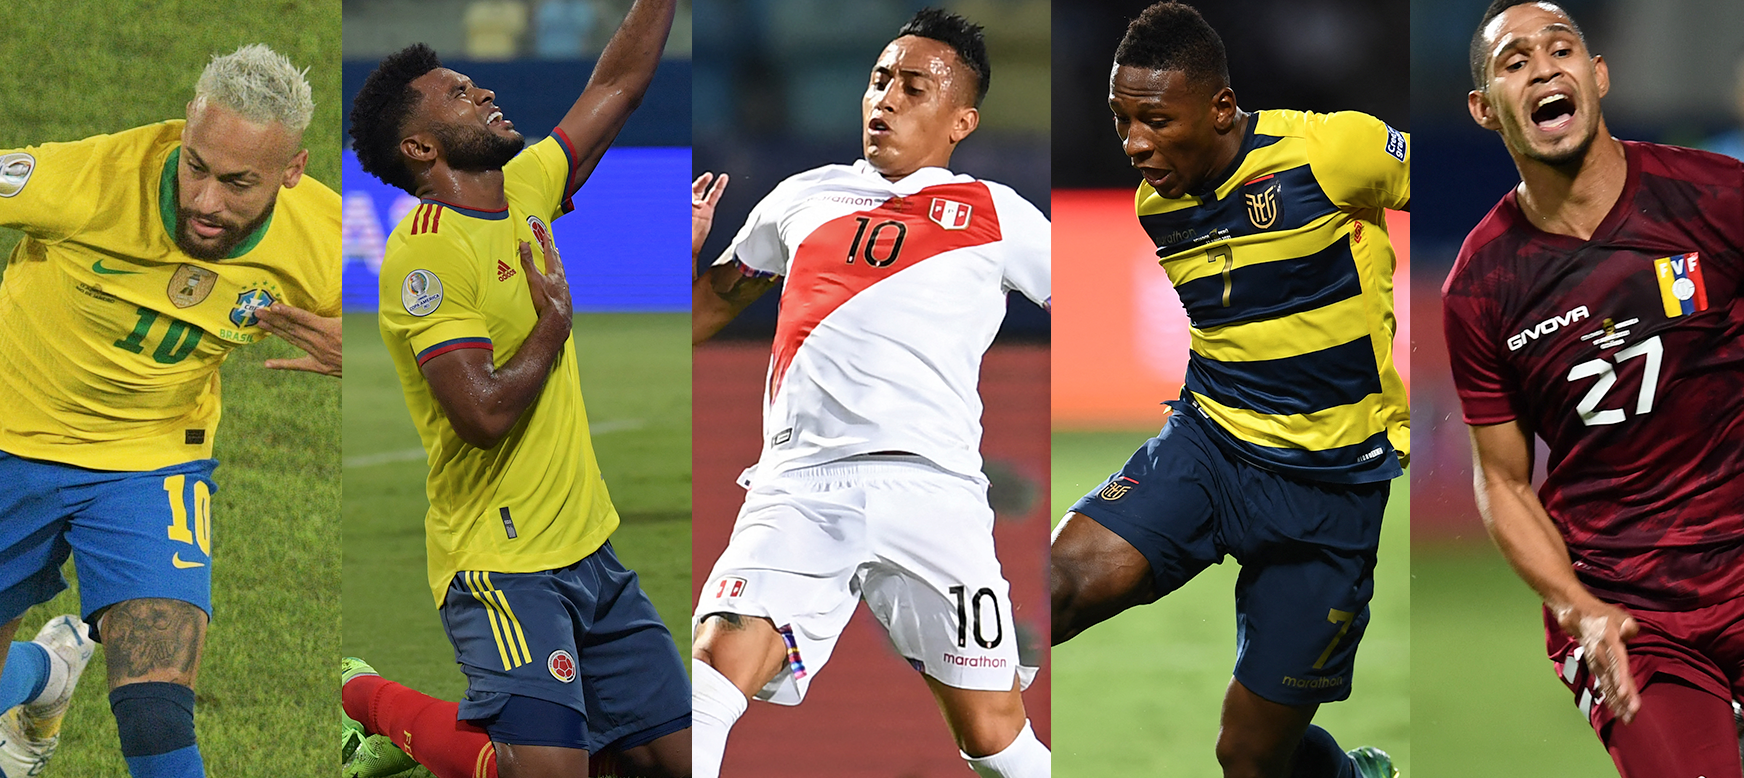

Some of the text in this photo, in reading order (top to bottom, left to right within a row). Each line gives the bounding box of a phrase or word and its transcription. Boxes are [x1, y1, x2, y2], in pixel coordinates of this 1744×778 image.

[845, 216, 908, 268] 10
[498, 269, 517, 282] adidas
[1205, 244, 1233, 308] 7
[113, 305, 205, 365] 10
[220, 328, 254, 343] BRASIL
[1507, 305, 1590, 351] GIVOVA
[1567, 335, 1664, 426] 27
[163, 474, 211, 557] 10
[948, 585, 1002, 649] 10
[1312, 608, 1355, 670] 7
[943, 652, 1007, 668] marathon
[1282, 675, 1343, 689] marathon
